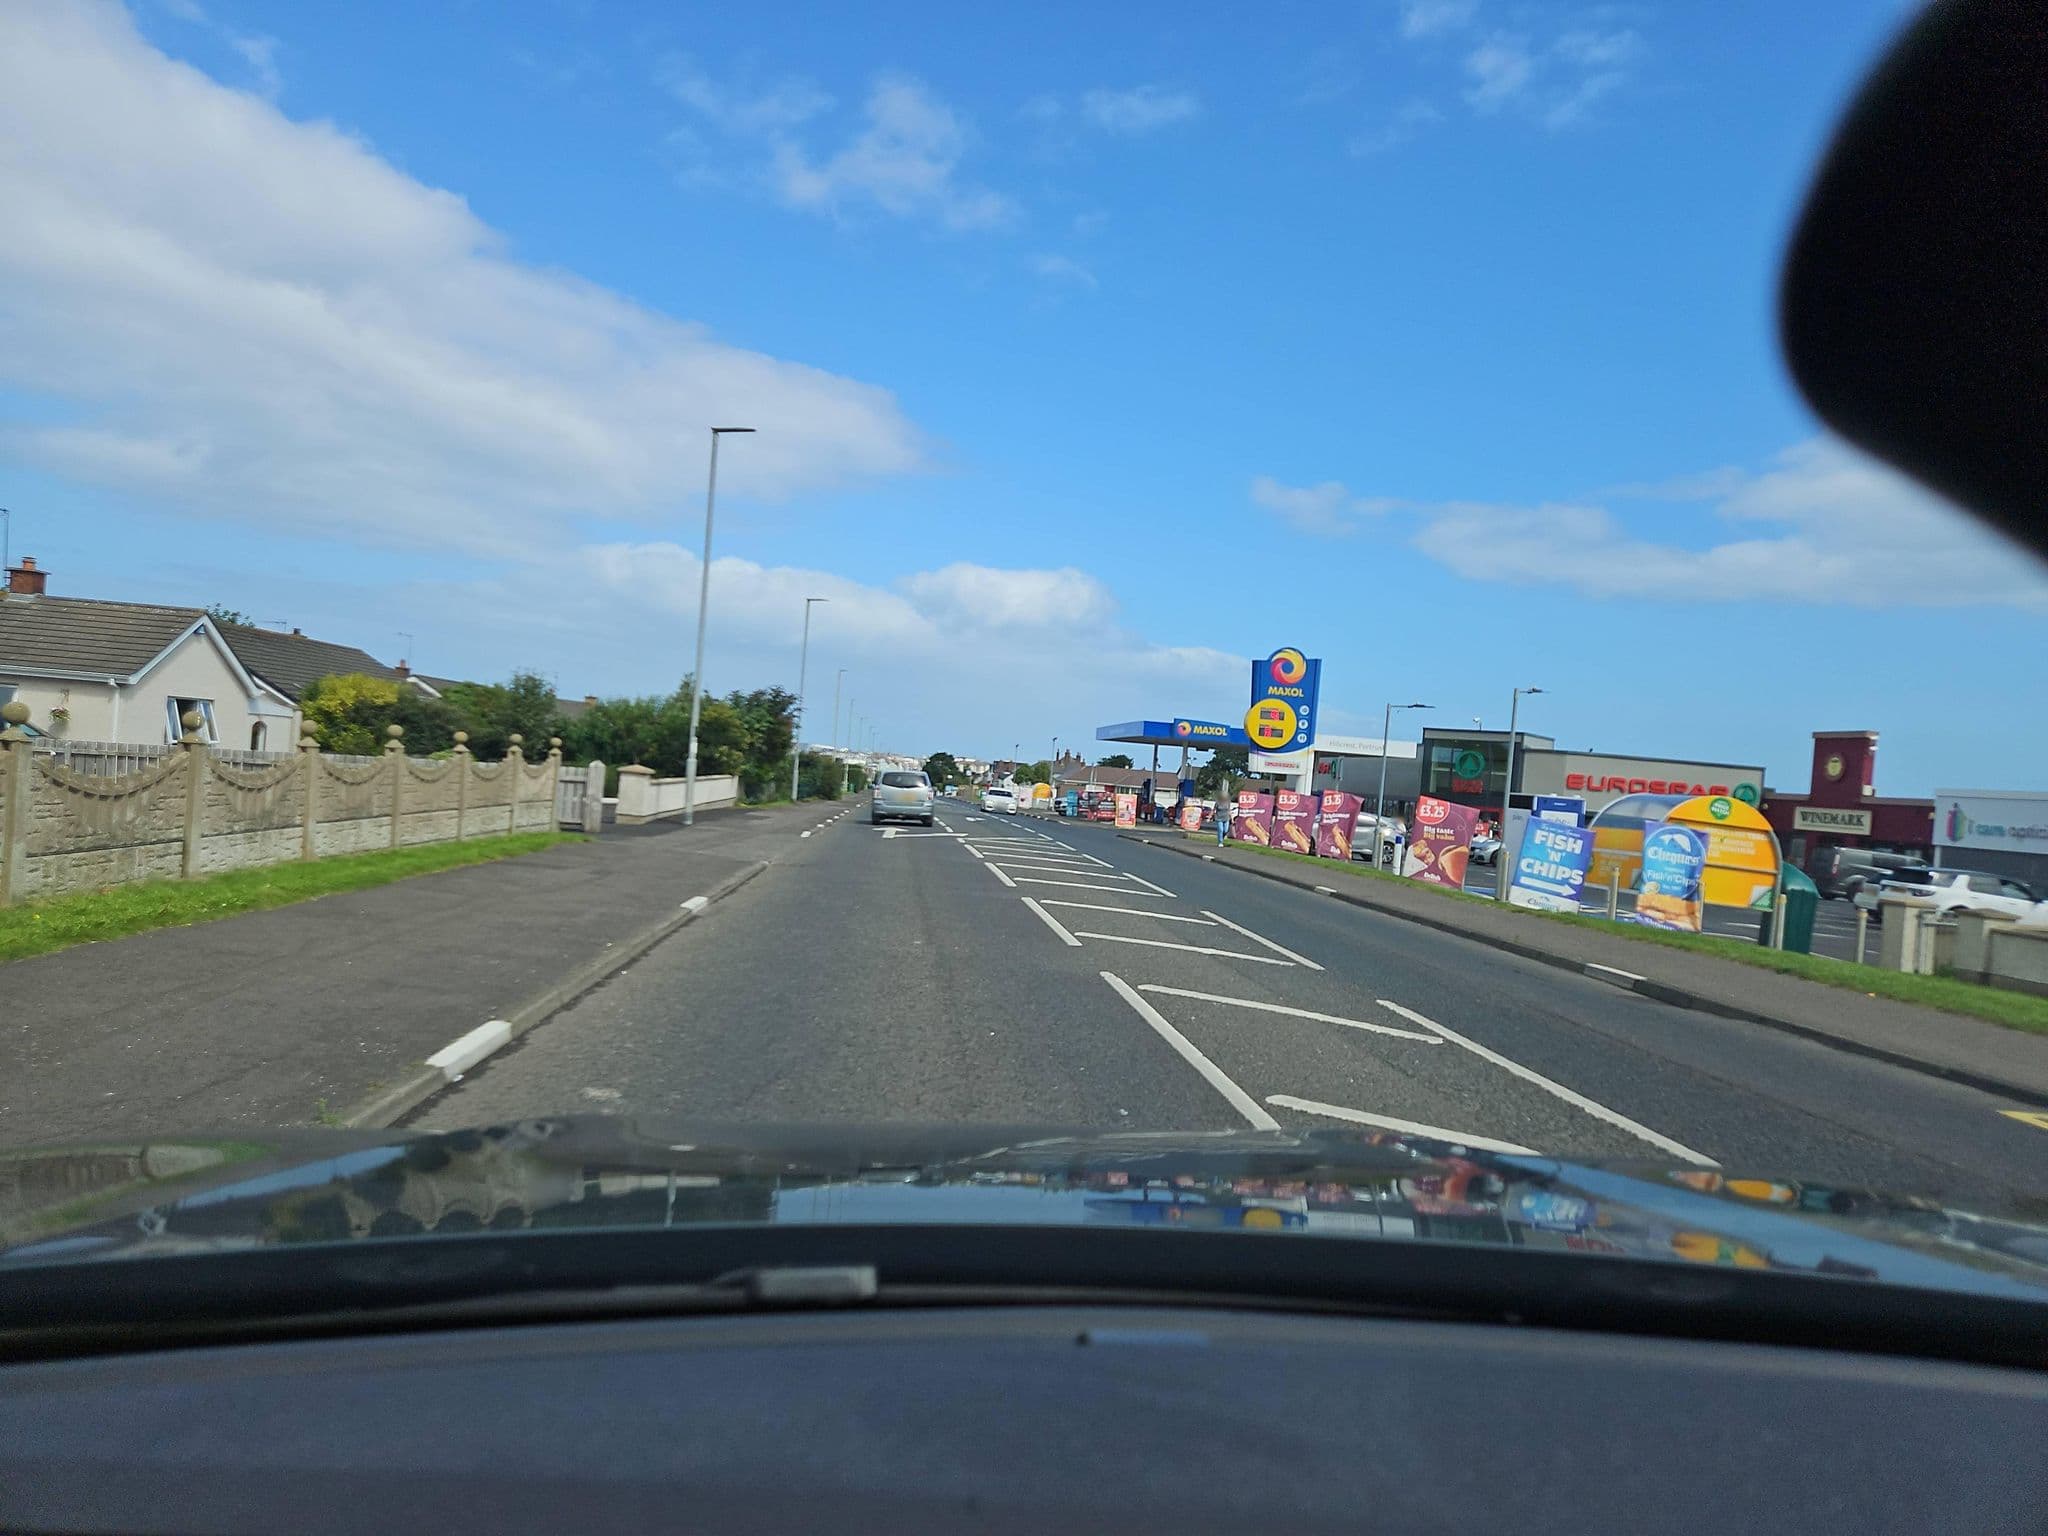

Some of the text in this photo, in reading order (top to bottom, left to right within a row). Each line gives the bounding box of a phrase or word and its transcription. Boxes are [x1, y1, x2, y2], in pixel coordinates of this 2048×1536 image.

[1267, 686, 1305, 698] MAXOL
[1193, 725, 1228, 737] MAXOL
[1566, 773, 1729, 796] EUROSPAR
[1420, 804, 1445, 818] £3.25
[1800, 810, 1865, 827] WINEMARK
[1423, 825, 1436, 834] Big
[1534, 829, 1584, 854] FISH
[1520, 857, 1584, 885] CHIPS
